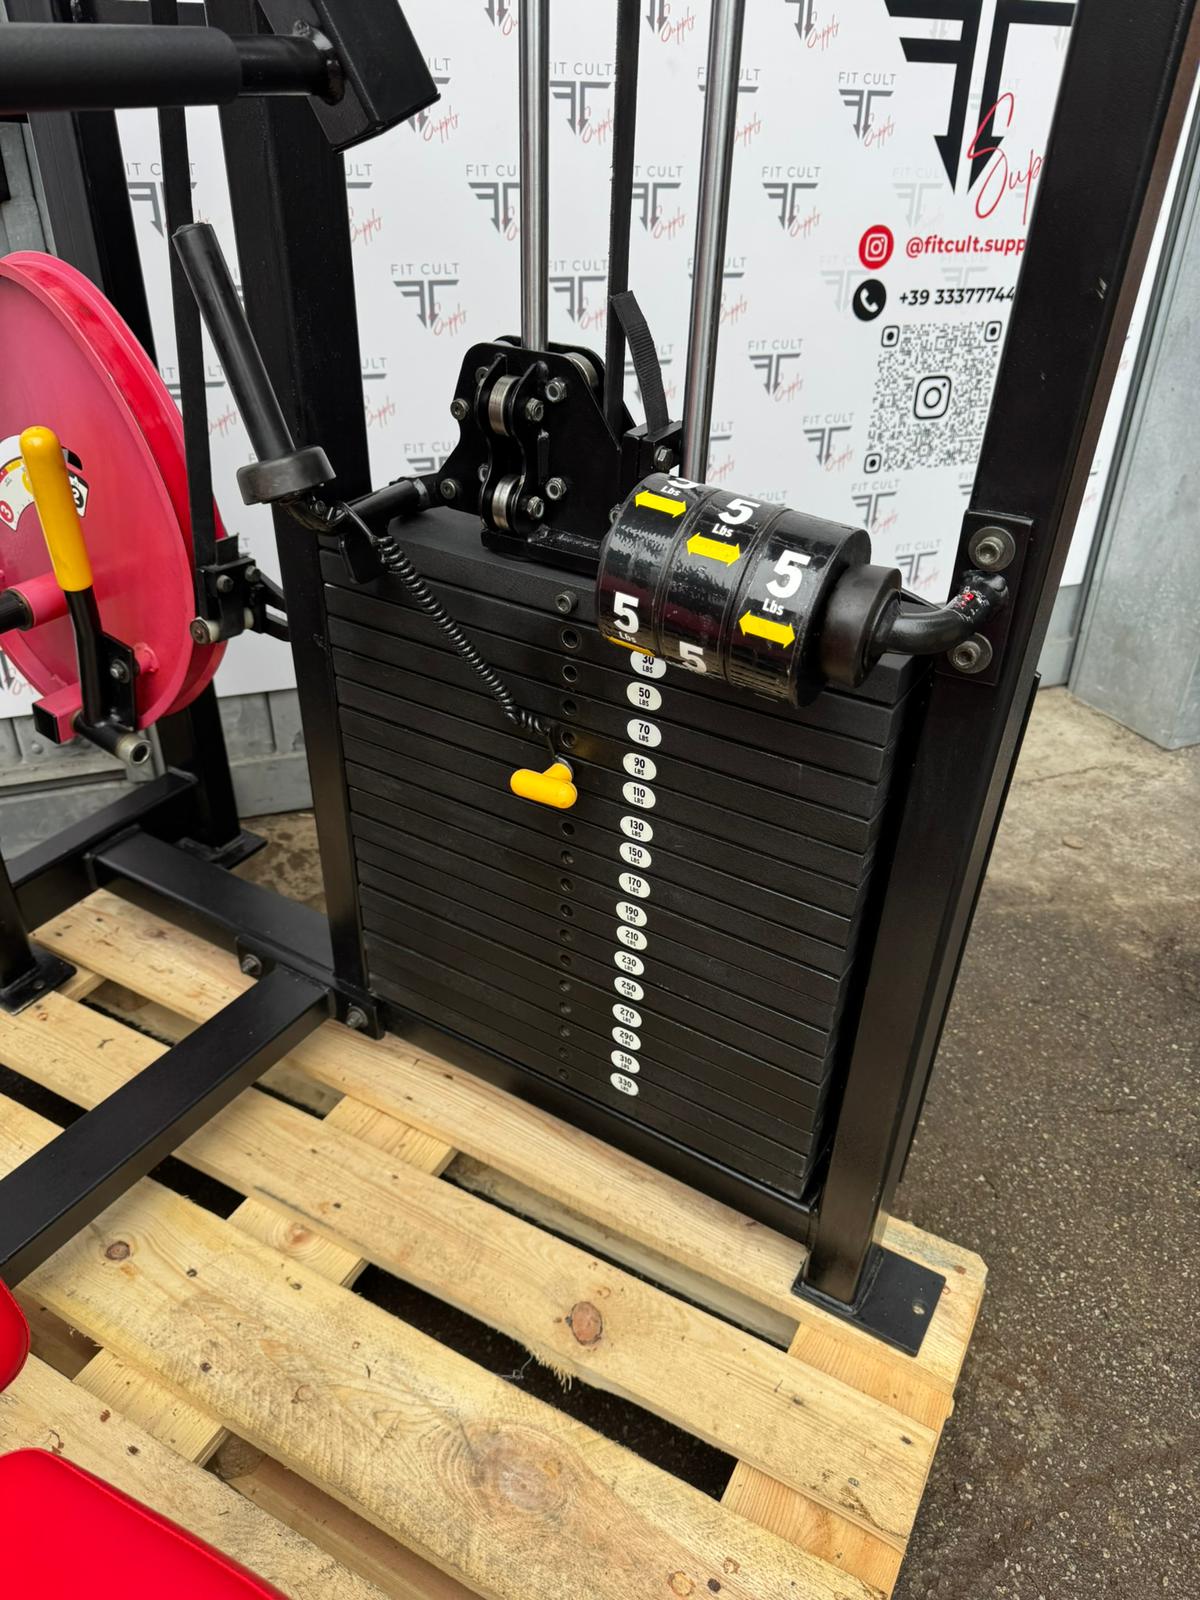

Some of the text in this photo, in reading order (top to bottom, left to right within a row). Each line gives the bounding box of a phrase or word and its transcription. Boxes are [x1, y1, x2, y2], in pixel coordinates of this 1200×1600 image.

[430, 58, 451, 71] LT
[573, 63, 614, 76] CULT
[739, 69, 761, 81] ULT
[838, 72, 896, 86] FIT CULT
[734, 112, 762, 147] upply
[967, 92, 1046, 225] Sup
[126, 163, 141, 175] IT
[345, 164, 373, 176] ULT
[466, 165, 519, 177] FIT CU
[647, 166, 684, 178] CULT
[762, 166, 821, 178] FIT CULT
[906, 235, 1025, 258] @fitcult.supp
[391, 263, 460, 275] FIT CULT
[572, 260, 608, 272] CULT
[724, 257, 748, 269] ULT
[899, 287, 1014, 306] +39 33377744
[748, 339, 803, 351] FIT CULT
[362, 358, 387, 370] ULT
[803, 412, 854, 425] FIT CULT
[711, 421, 733, 433] ULT
[404, 440, 459, 452] FIT CU
[661, 485, 680, 497] Lbs
[851, 479, 900, 492] FIT CULT
[718, 498, 761, 525] 5
[712, 523, 734, 538] Lbs
[895, 539, 943, 553] FIT CULT
[766, 550, 811, 599] 5
[613, 591, 640, 634] 5
[762, 598, 784, 616] Lbs
[642, 656, 654, 665] 30
[679, 641, 709, 674] 5
[642, 666, 653, 674] LBS
[639, 687, 651, 699] 50
[639, 698, 650, 707] LBS
[638, 723, 650, 735] 70
[639, 734, 649, 743] LBS
[634, 757, 646, 769] 90
[634, 767, 645, 776] LBS
[633, 786, 646, 798] 110
[634, 797, 644, 805] LBS
[630, 819, 644, 832] 130
[631, 830, 642, 838] LBS
[628, 846, 643, 859] 150
[630, 856, 640, 865] LBS
[628, 876, 642, 888] 170
[629, 886, 640, 894] LBS
[625, 905, 639, 917] 190
[625, 930, 639, 942] 210
[621, 955, 637, 967] 230
[621, 980, 637, 993] 250
[620, 1007, 635, 1019] 270
[619, 1030, 634, 1042] 290
[619, 1054, 633, 1066] 310
[618, 1076, 632, 1088] 330
